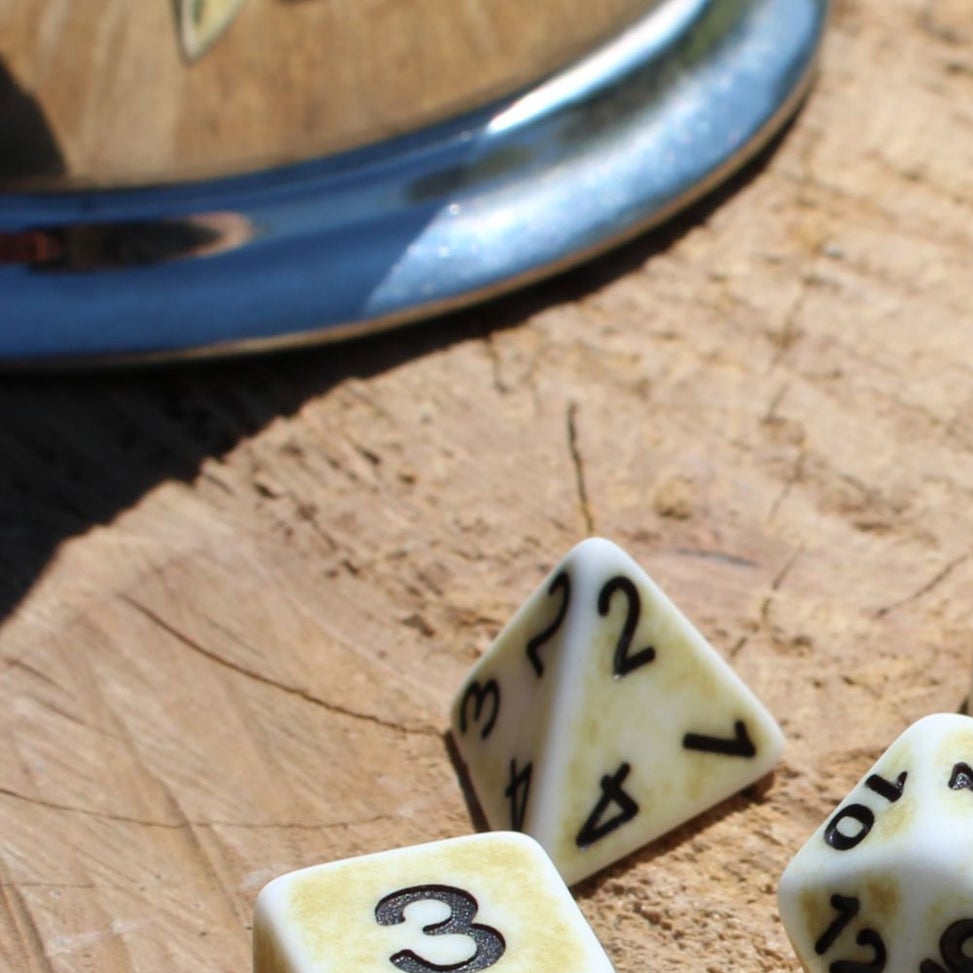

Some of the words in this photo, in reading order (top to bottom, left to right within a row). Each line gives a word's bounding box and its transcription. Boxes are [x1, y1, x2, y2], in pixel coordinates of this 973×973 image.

[598, 576, 656, 679] 2
[460, 679, 500, 740] 3
[682, 719, 756, 758] 1
[575, 763, 639, 848] 4
[824, 771, 907, 850] 10
